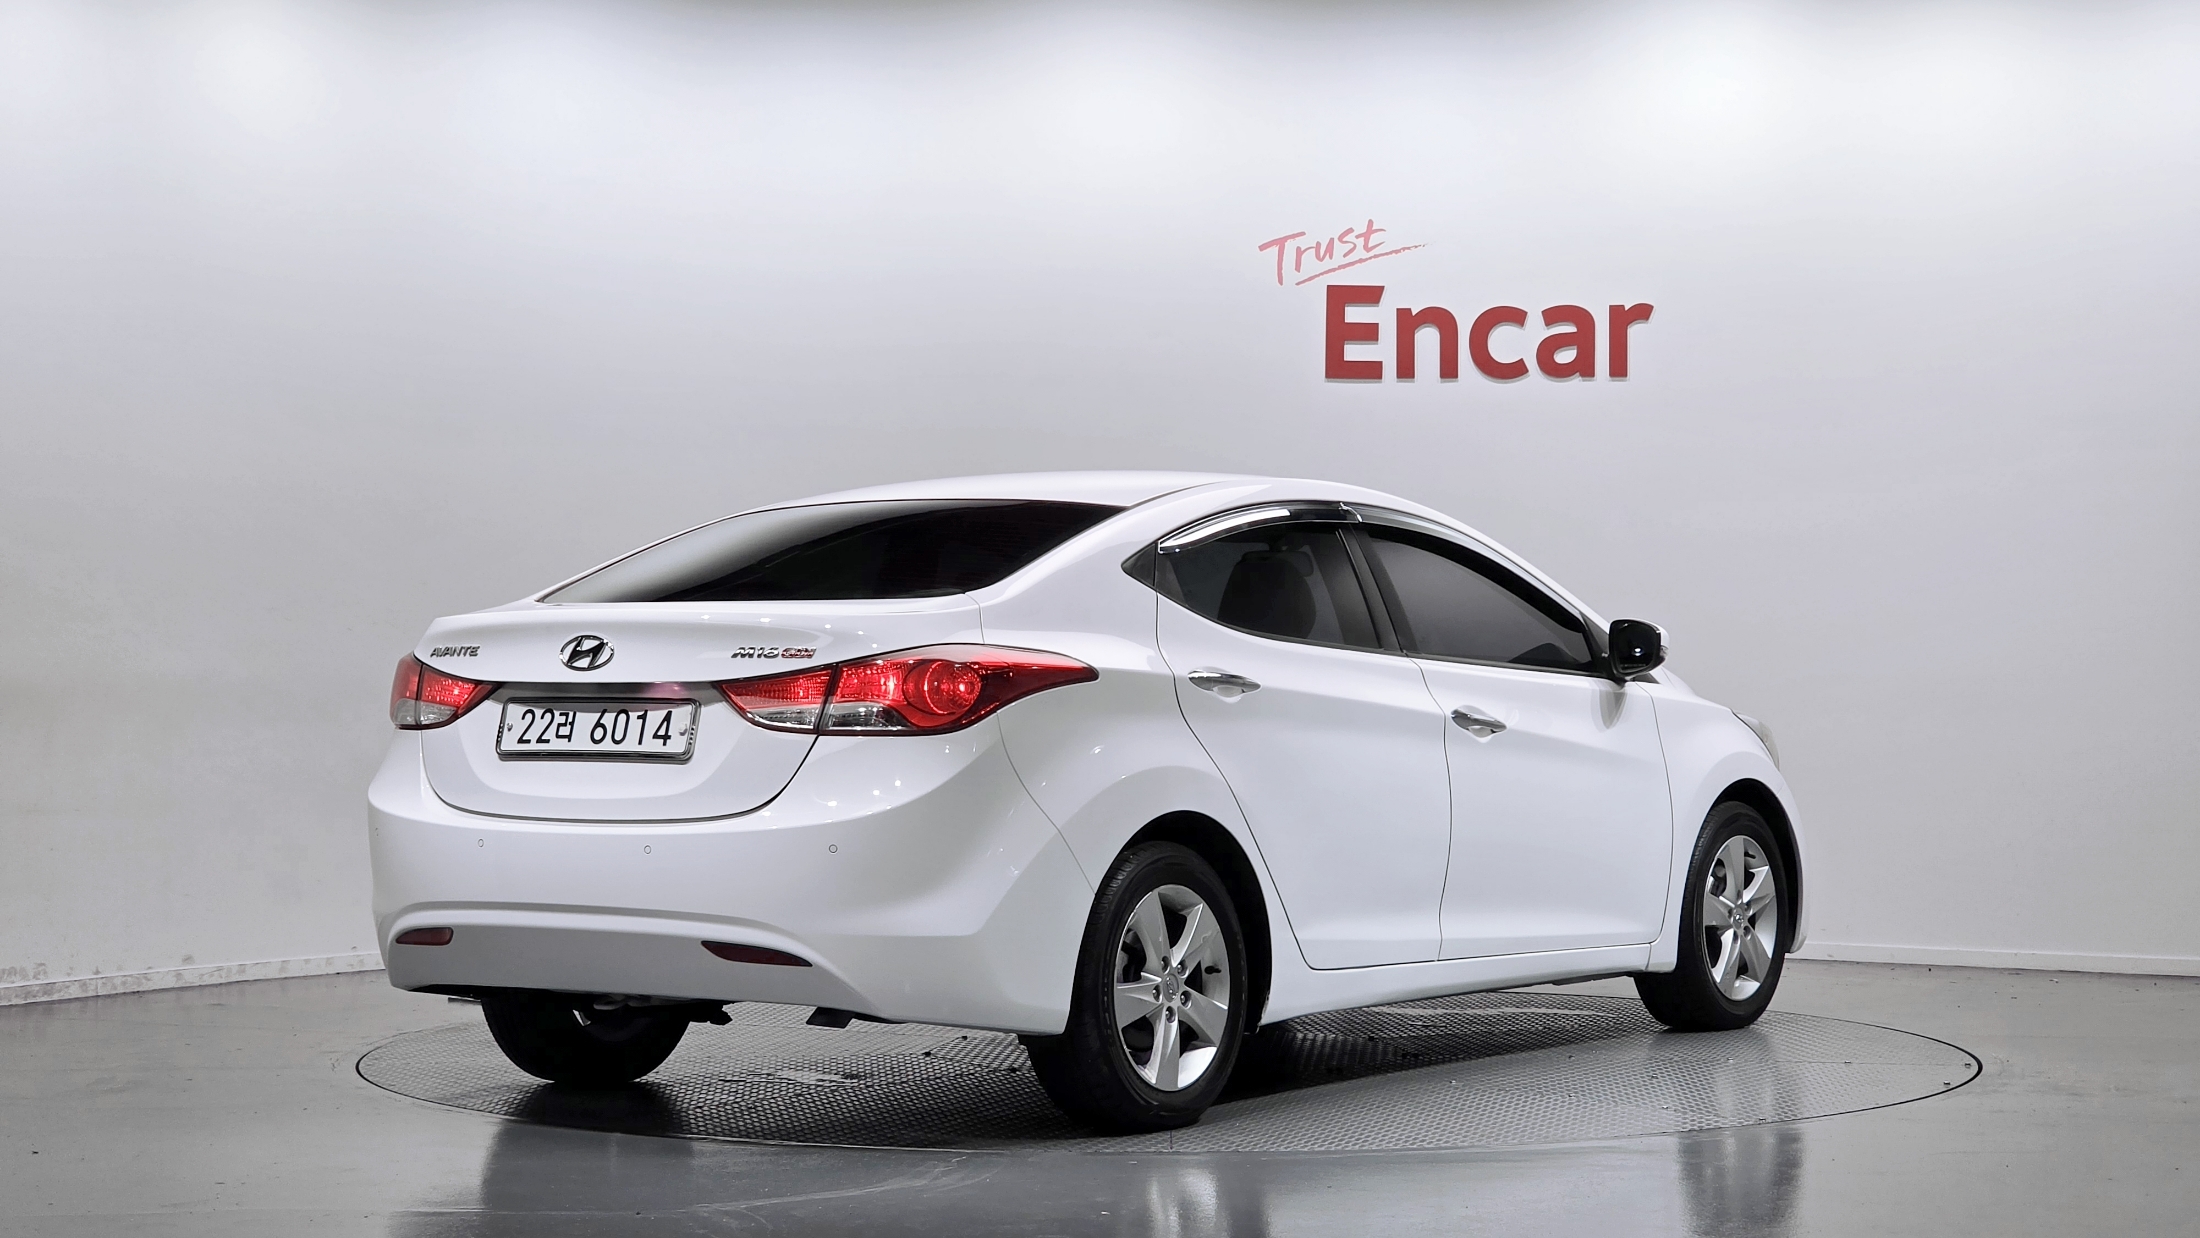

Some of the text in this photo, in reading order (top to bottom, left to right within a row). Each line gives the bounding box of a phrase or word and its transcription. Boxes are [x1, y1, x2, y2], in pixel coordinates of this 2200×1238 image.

[1258, 218, 1386, 286] Trust
[1325, 284, 1655, 382] Encar
[430, 645, 481, 658] AVANTE
[589, 708, 673, 747] 6014
